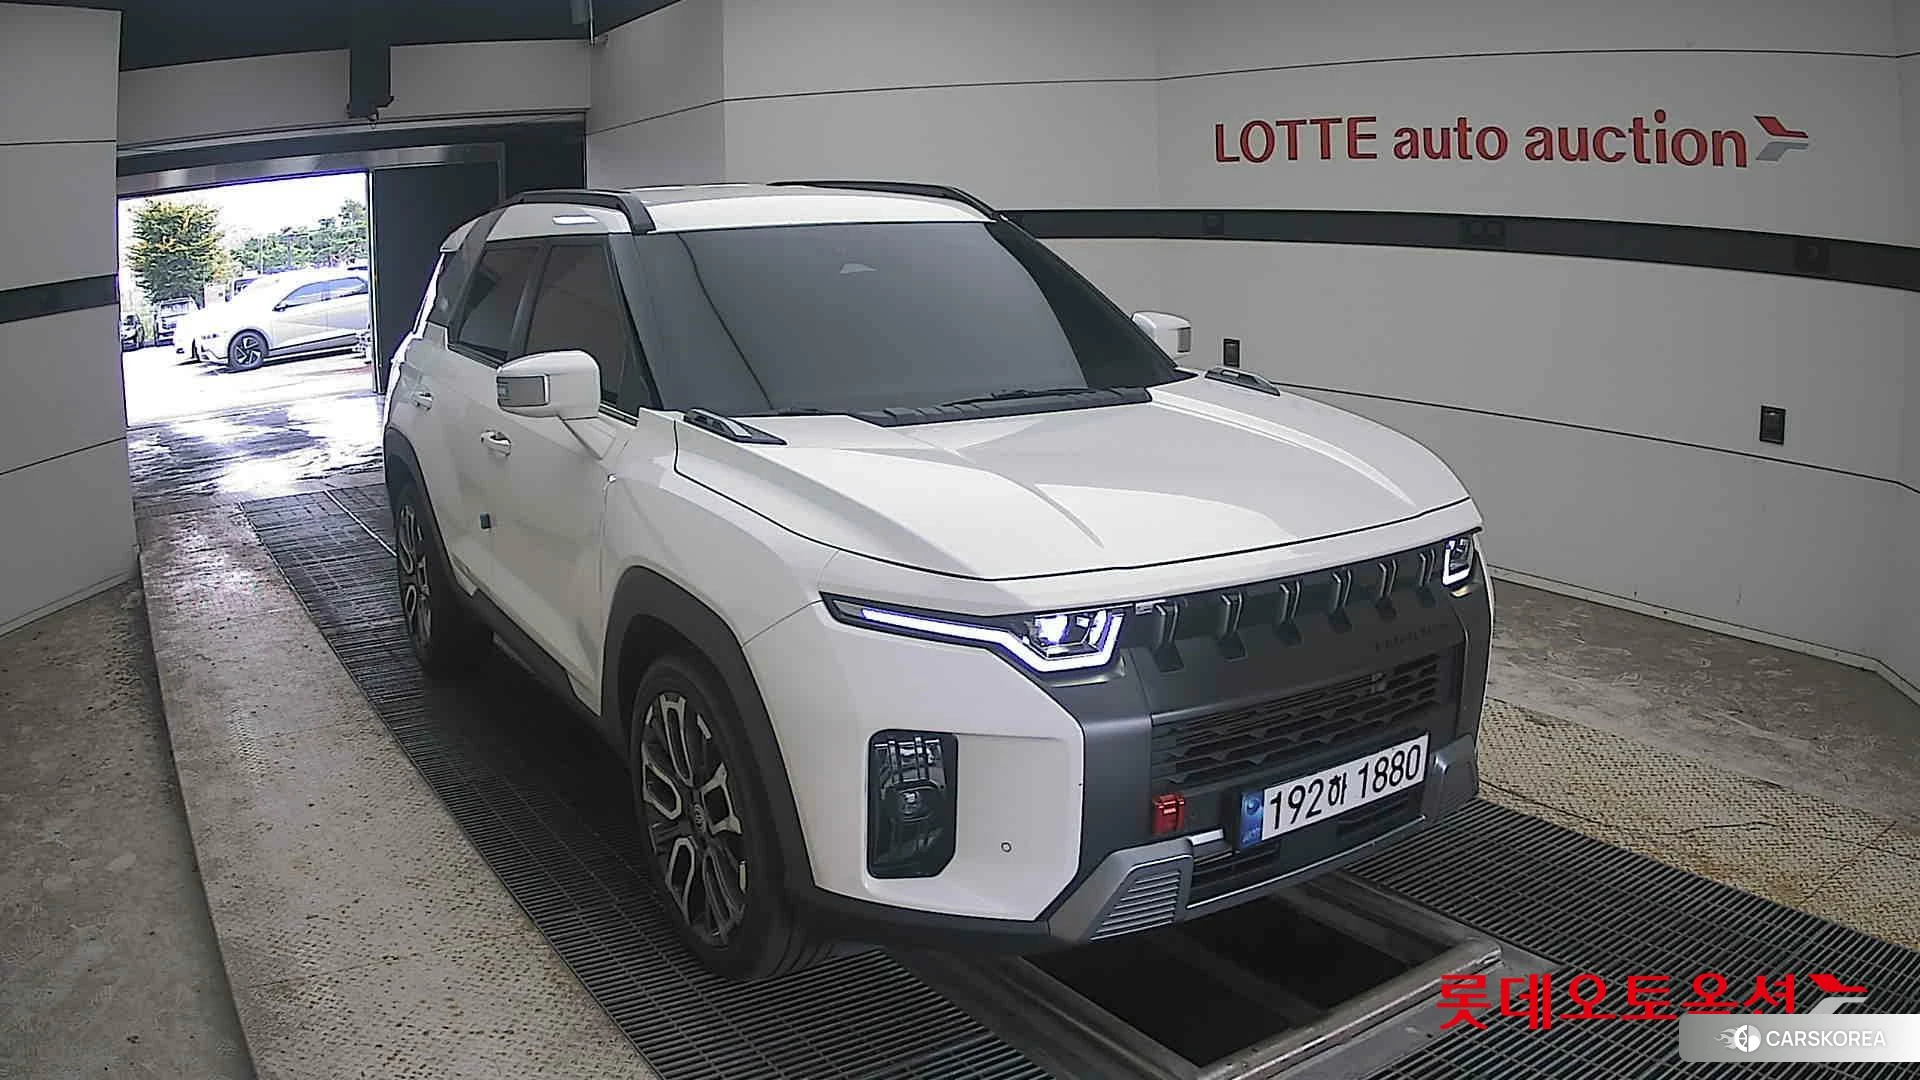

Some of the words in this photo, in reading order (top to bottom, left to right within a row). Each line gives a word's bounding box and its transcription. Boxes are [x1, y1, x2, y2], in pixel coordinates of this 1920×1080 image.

[1215, 116, 1377, 163] LOTTE
[1393, 117, 1509, 161] auto
[1524, 109, 1748, 168] auction
[1270, 772, 1347, 829] 192하
[1358, 744, 1421, 799] 1880
